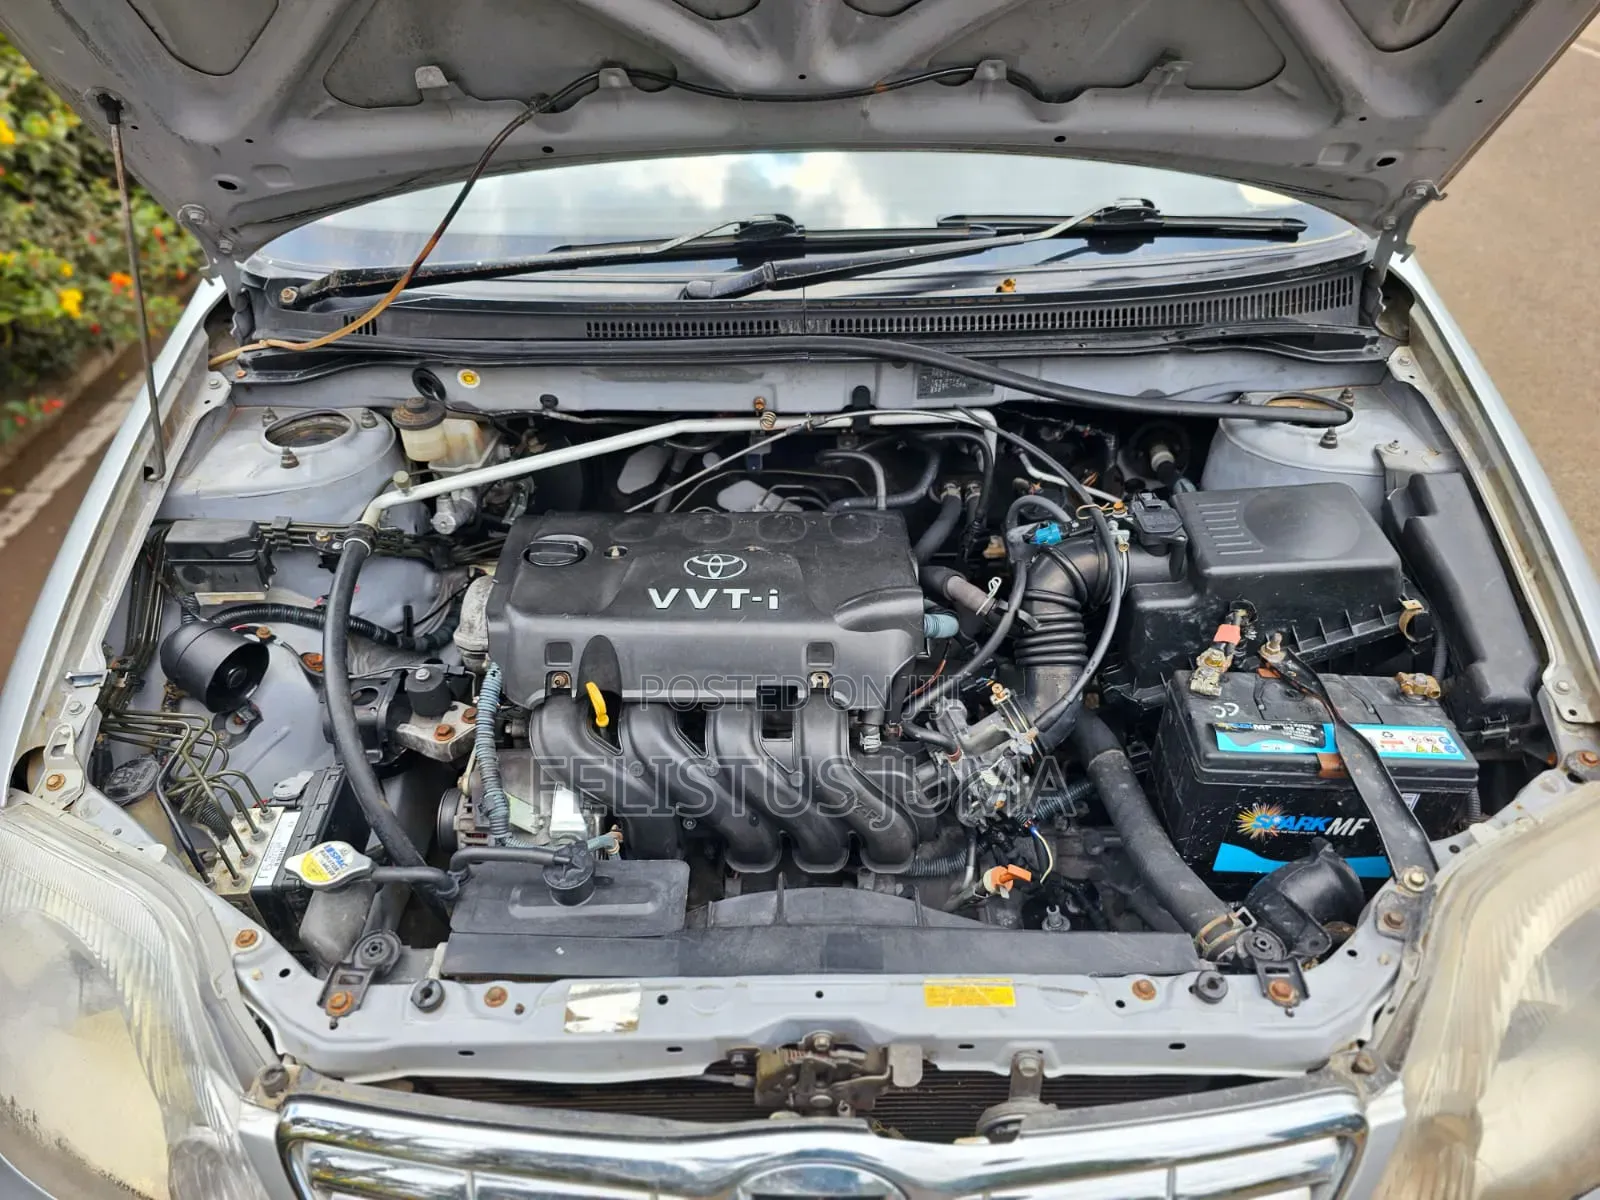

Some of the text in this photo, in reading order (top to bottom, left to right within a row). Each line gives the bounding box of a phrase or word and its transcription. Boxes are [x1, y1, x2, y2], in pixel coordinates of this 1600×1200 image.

[647, 588, 779, 610] VVT-i
[1251, 814, 1370, 836] SPARK MF
